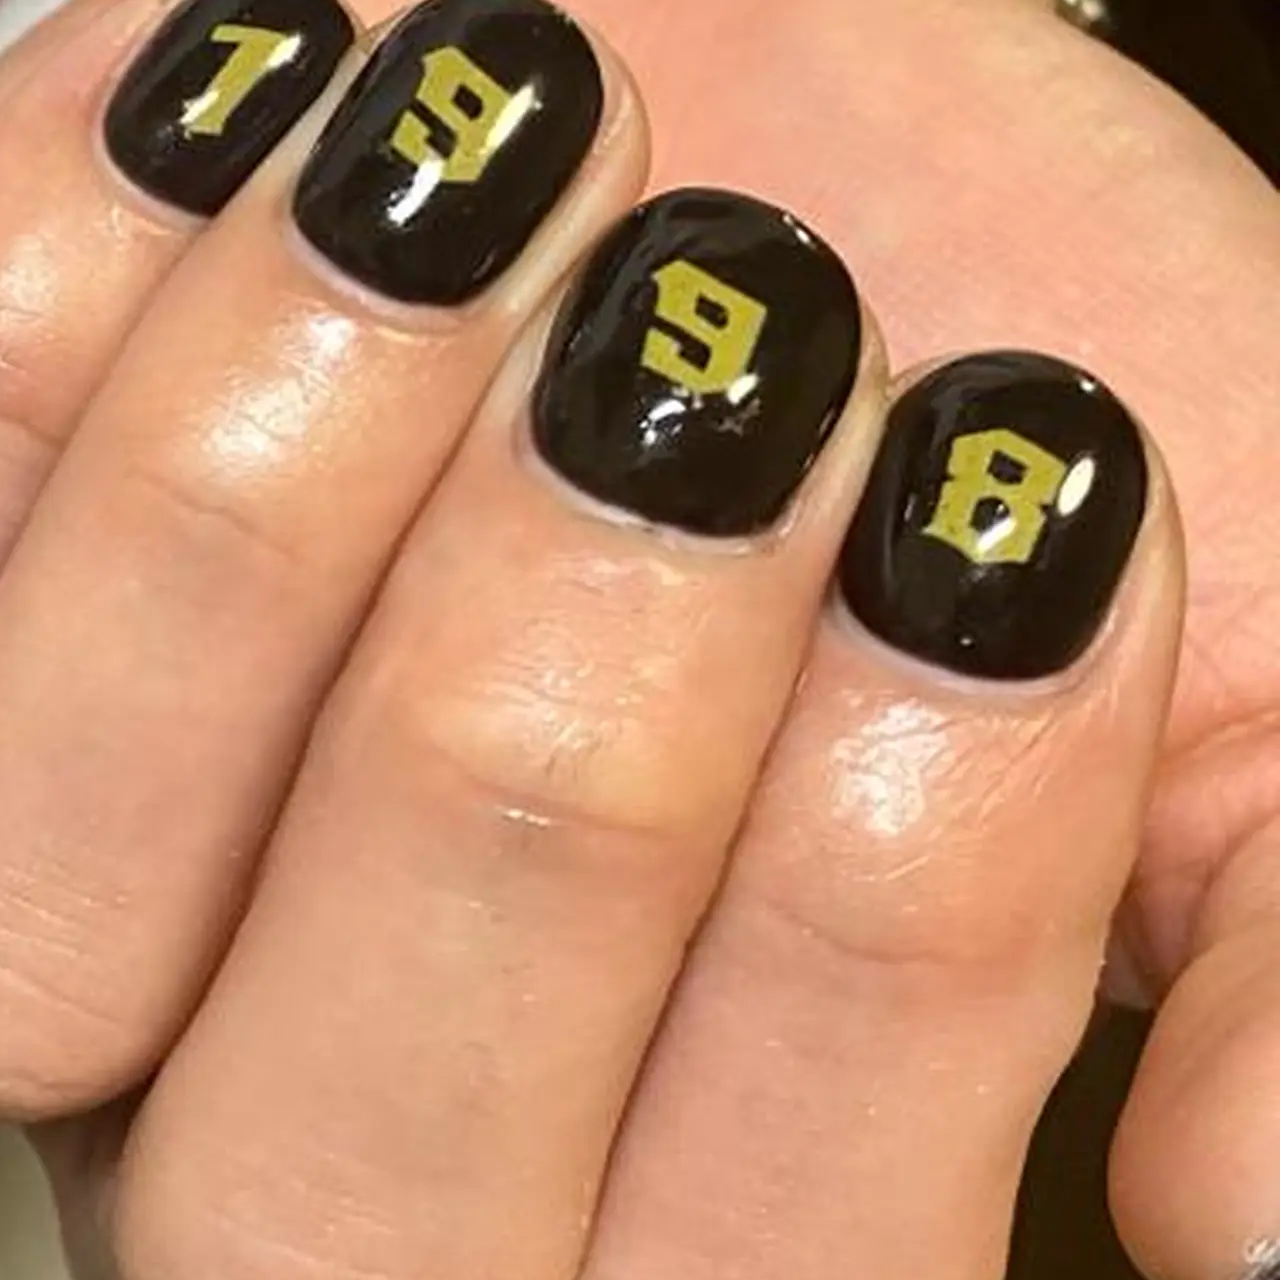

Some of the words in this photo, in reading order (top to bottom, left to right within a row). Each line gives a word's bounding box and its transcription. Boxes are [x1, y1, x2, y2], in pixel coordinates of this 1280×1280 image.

[181, 23, 298, 137] 1
[389, 45, 528, 183] 9
[642, 259, 768, 395] 9
[922, 428, 1069, 564] 8
